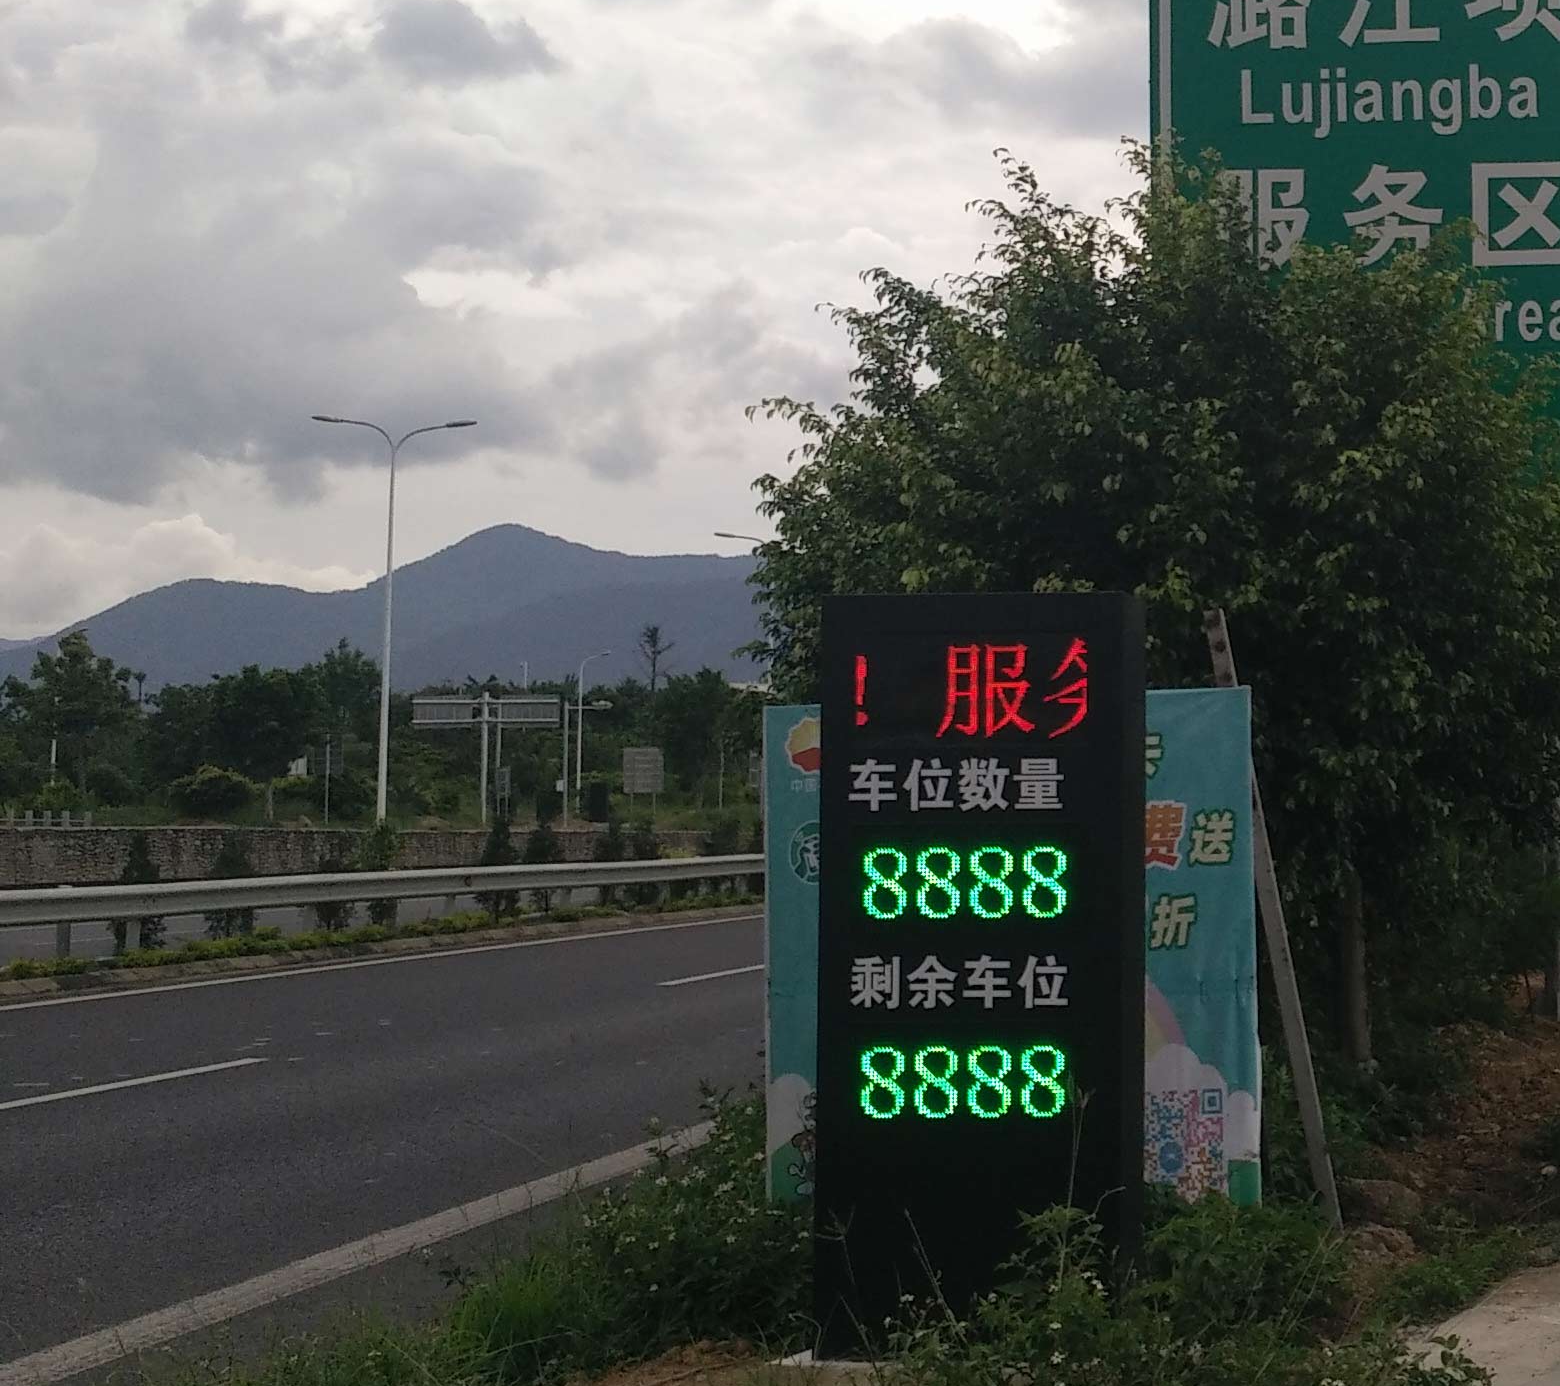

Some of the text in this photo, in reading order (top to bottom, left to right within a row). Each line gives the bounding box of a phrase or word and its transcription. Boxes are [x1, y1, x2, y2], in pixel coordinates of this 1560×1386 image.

[1240, 63, 1539, 139] Lujiangba
[848, 756, 1065, 812] 车位数量
[862, 845, 1068, 920] 8888
[1150, 895, 1196, 949] 折
[849, 954, 1070, 1010] 剩余车位
[859, 1044, 1067, 1120] 8888
